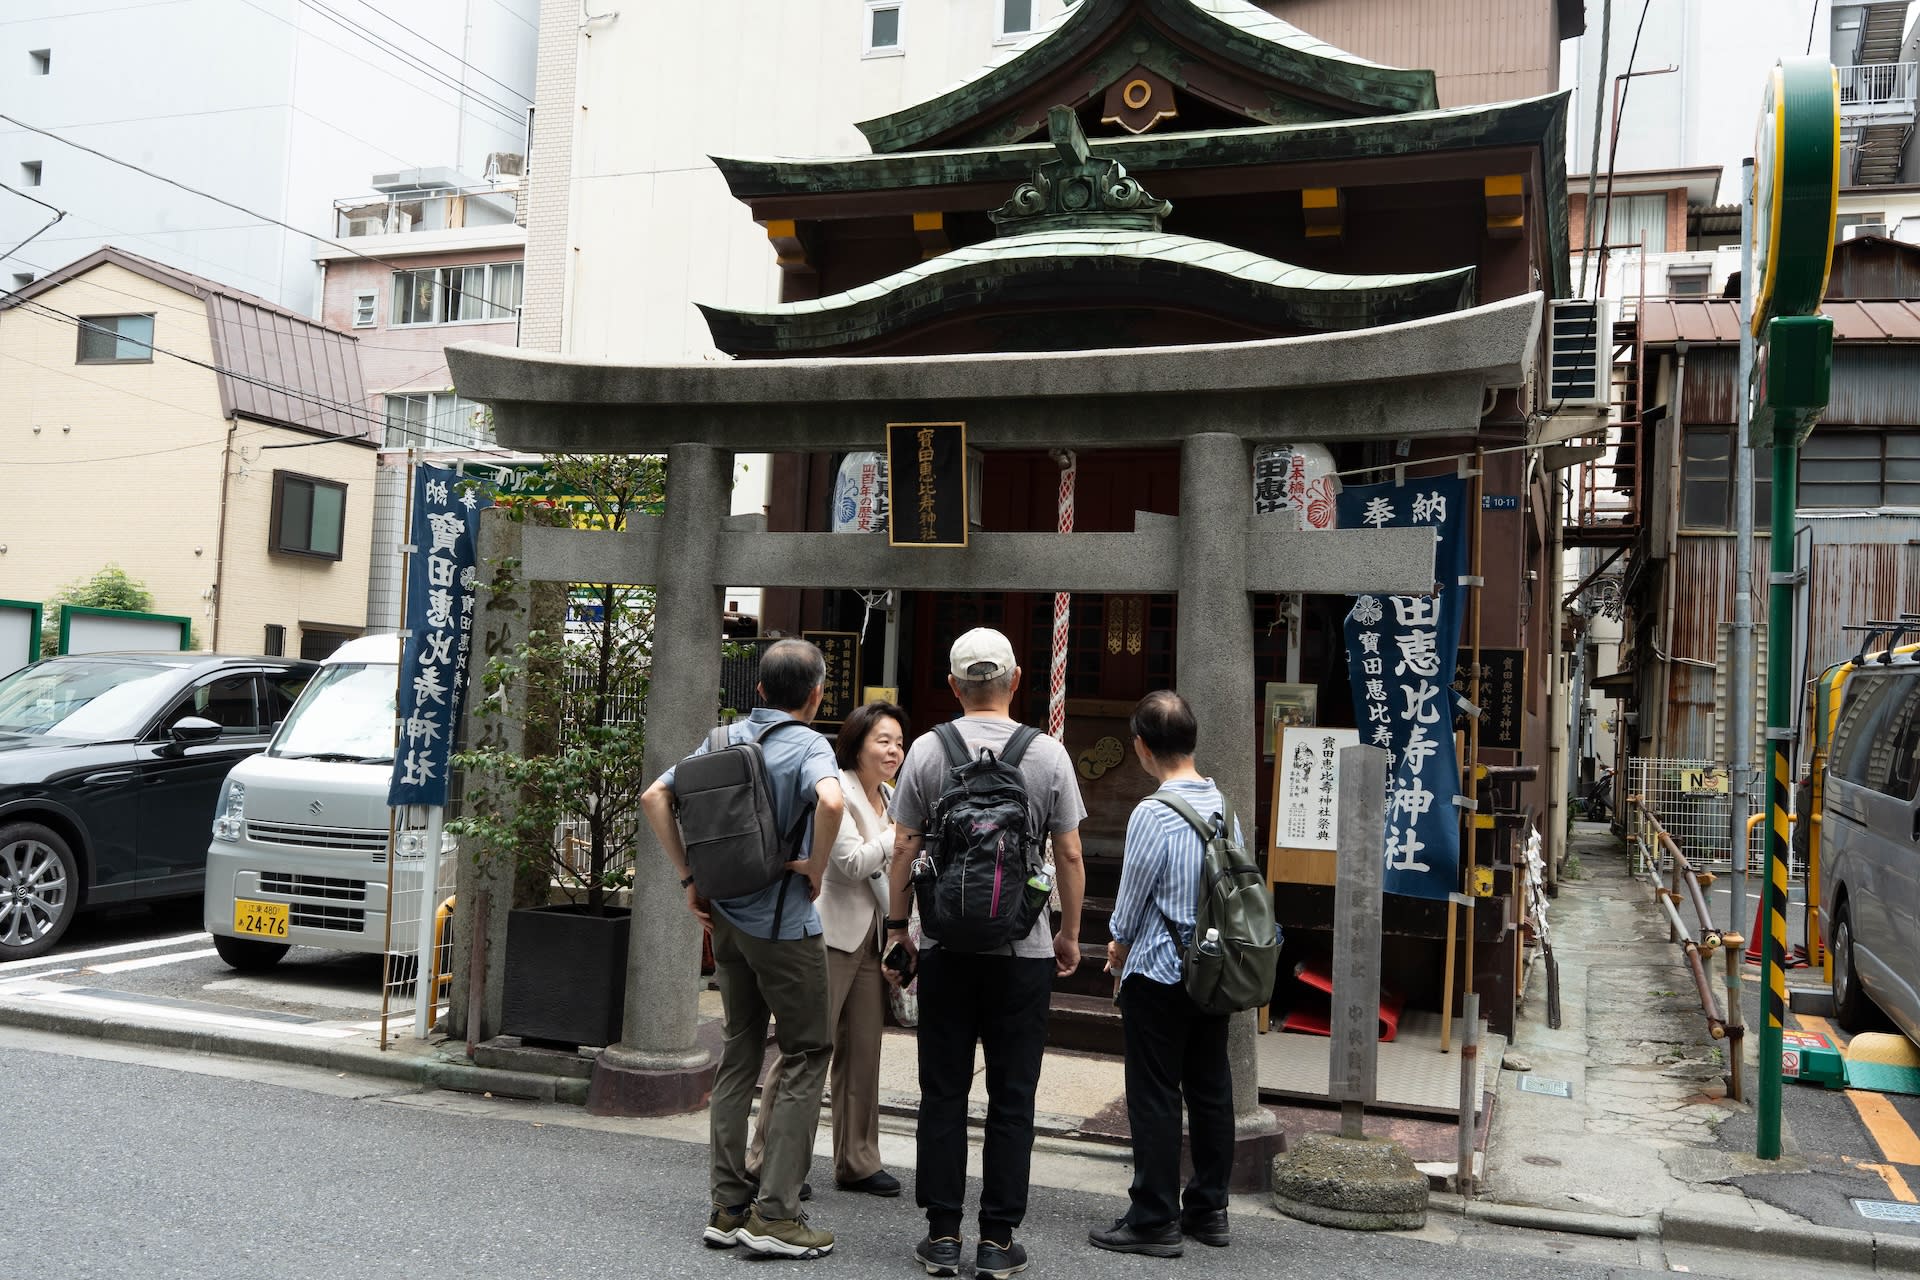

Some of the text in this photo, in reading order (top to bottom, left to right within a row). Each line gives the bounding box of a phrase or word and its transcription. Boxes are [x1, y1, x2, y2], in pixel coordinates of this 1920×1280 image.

[857, 463, 876, 532] 四百年の歴史
[1493, 498, 1515, 508] 10-11
[1384, 594, 1442, 873] 田恵比寿神社
[263, 905, 277, 915] 480
[246, 915, 285, 935] 24-76
